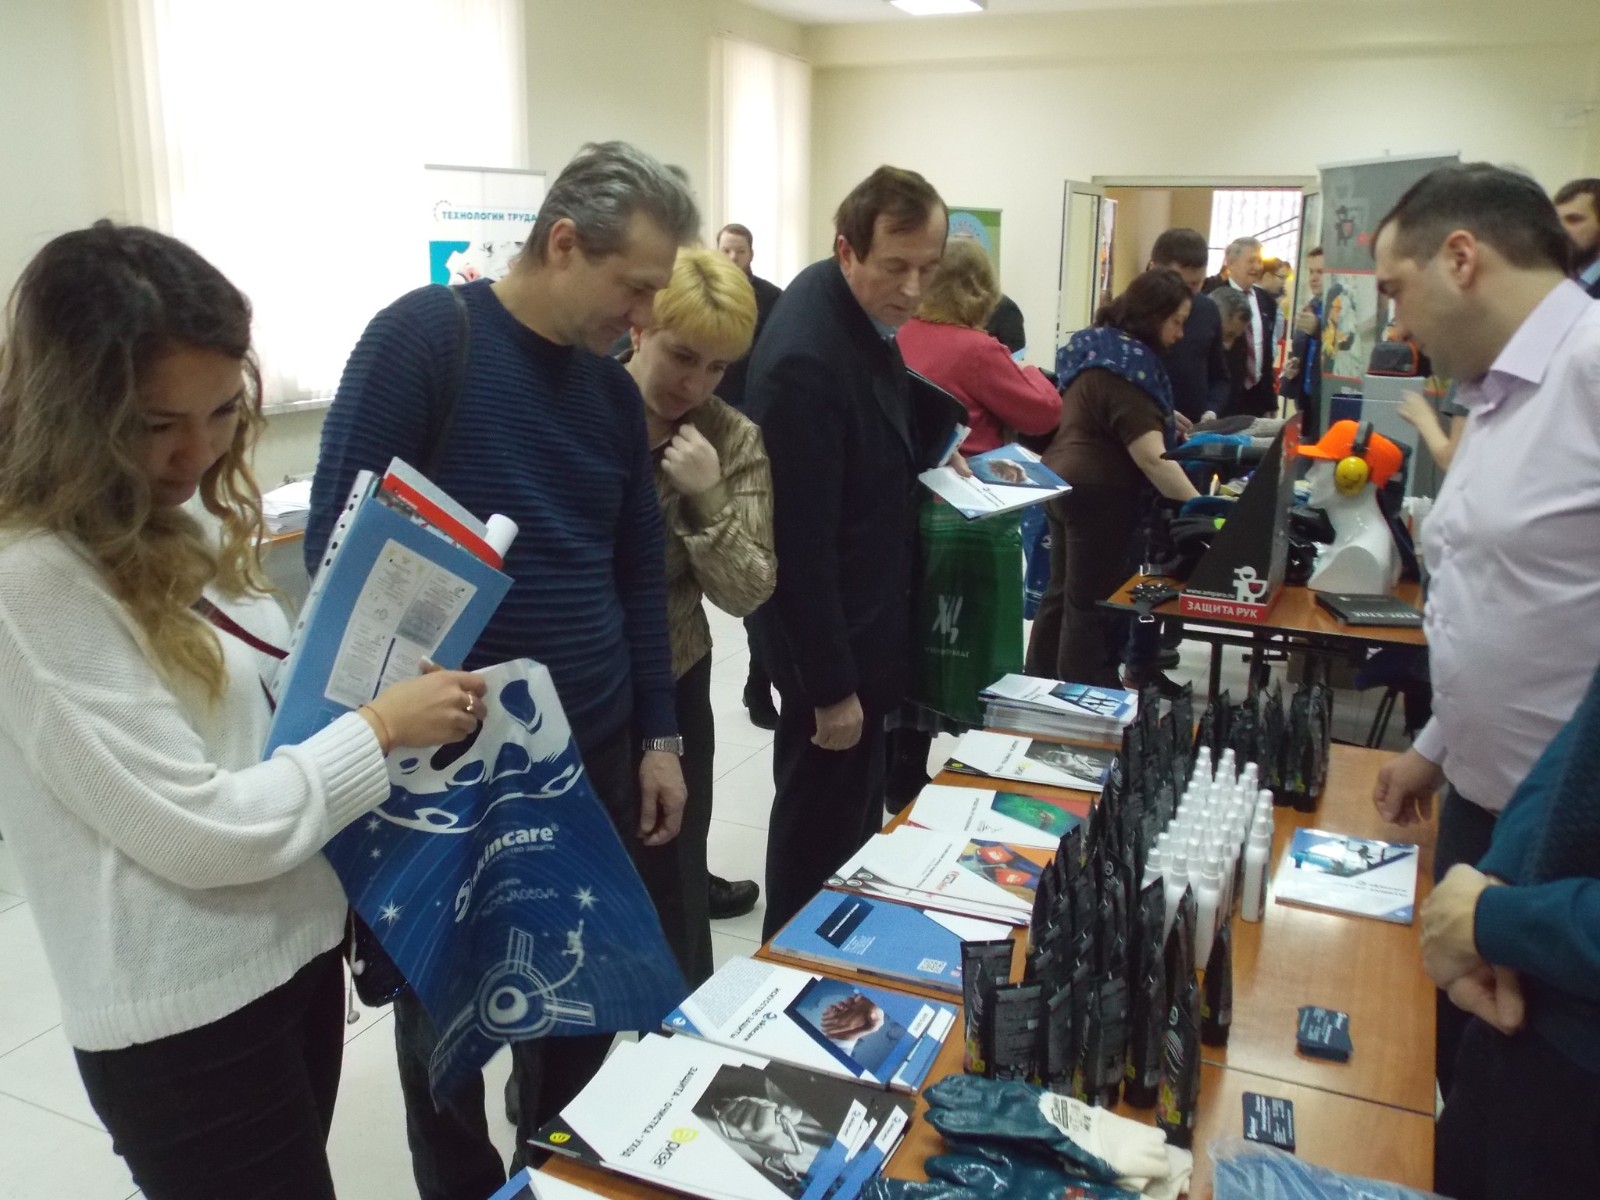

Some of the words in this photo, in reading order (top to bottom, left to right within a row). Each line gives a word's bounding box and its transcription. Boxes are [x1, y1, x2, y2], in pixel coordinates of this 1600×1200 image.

[442, 211, 504, 220] ТЕХНОЛОГИИ
[508, 213, 537, 223] ТРУДА
[1187, 601, 1234, 615] ЗАЩИТА
[1236, 607, 1258, 618] РУК
[672, 1066, 698, 1097] ЗАЩИТА
[643, 1102, 672, 1133] ОЧИСТКА
[621, 1139, 642, 1158] УХОД
